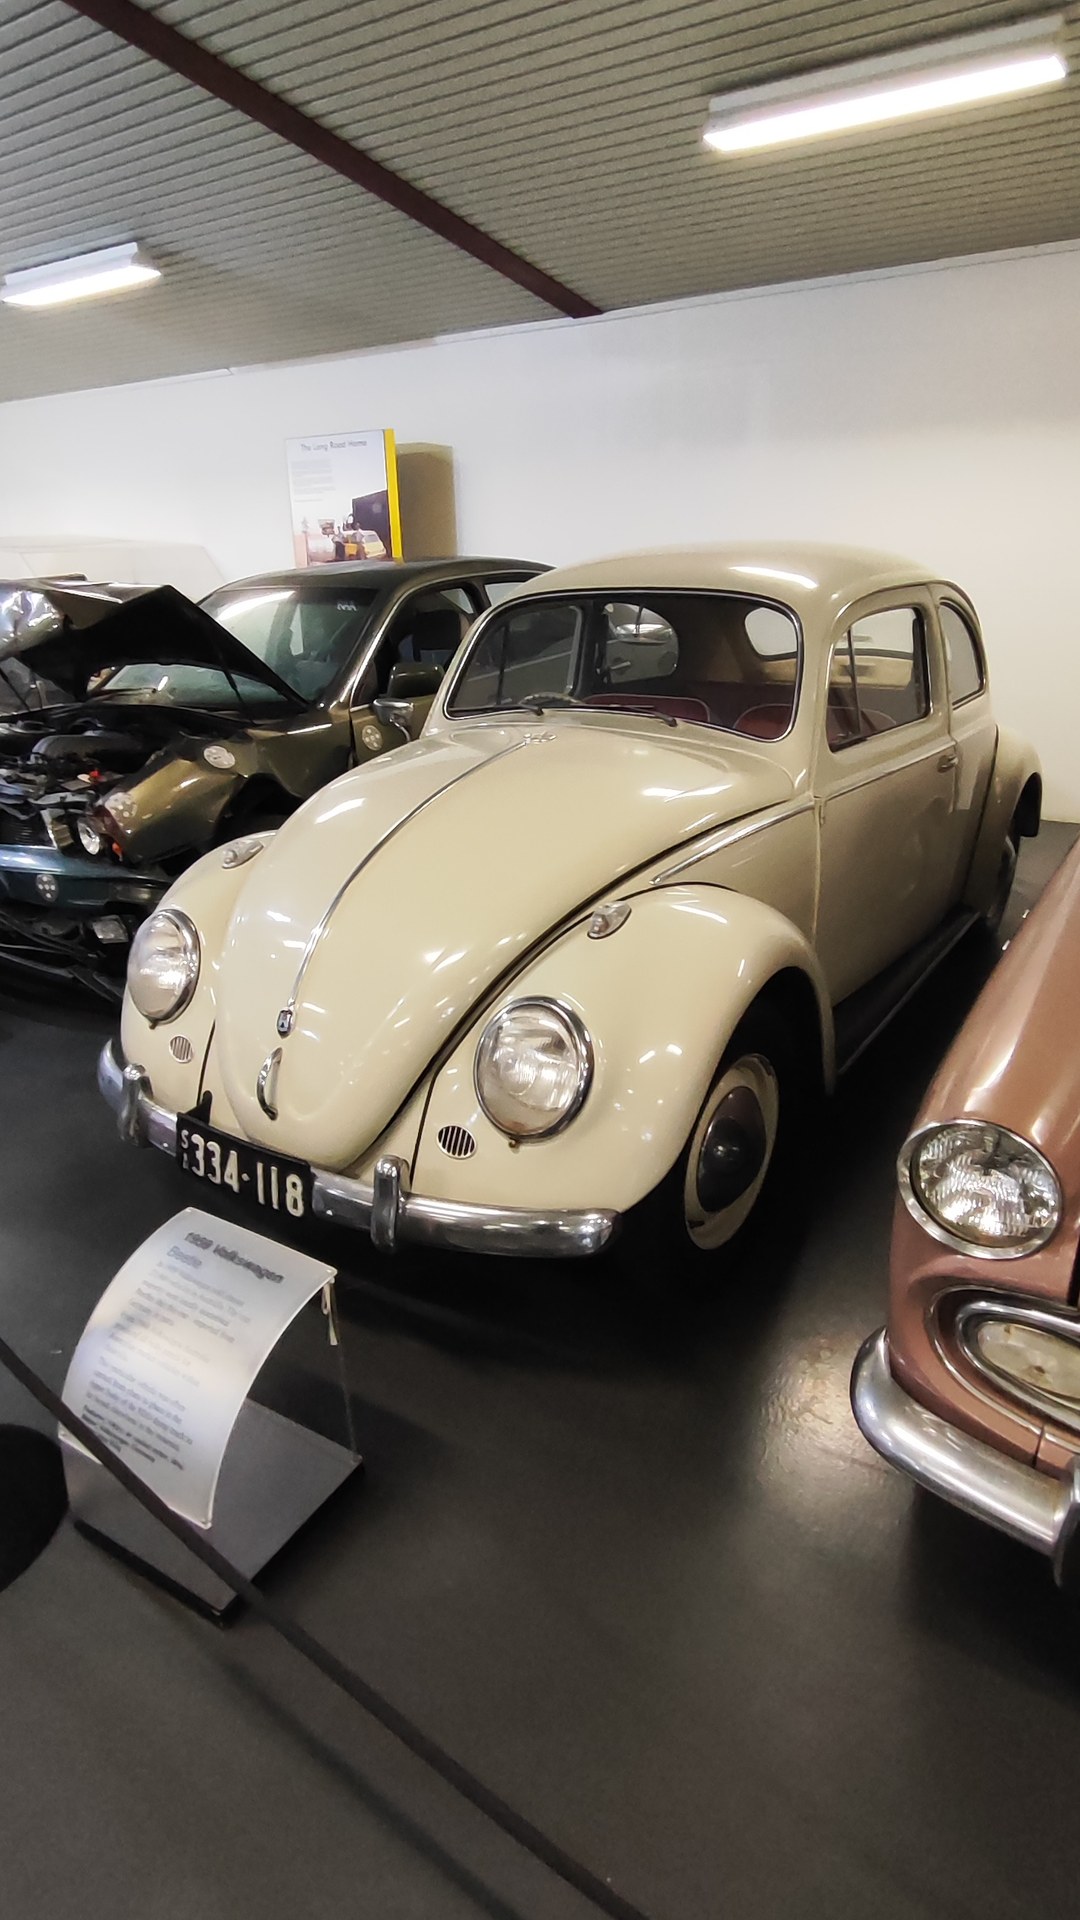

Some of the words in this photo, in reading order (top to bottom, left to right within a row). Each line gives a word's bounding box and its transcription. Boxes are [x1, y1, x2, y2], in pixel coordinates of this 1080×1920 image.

[300, 443, 311, 451] The
[313, 442, 328, 452] Long
[330, 440, 346, 449] Road
[348, 439, 367, 447] Home
[213, 1244, 285, 1284] Volkswagen
